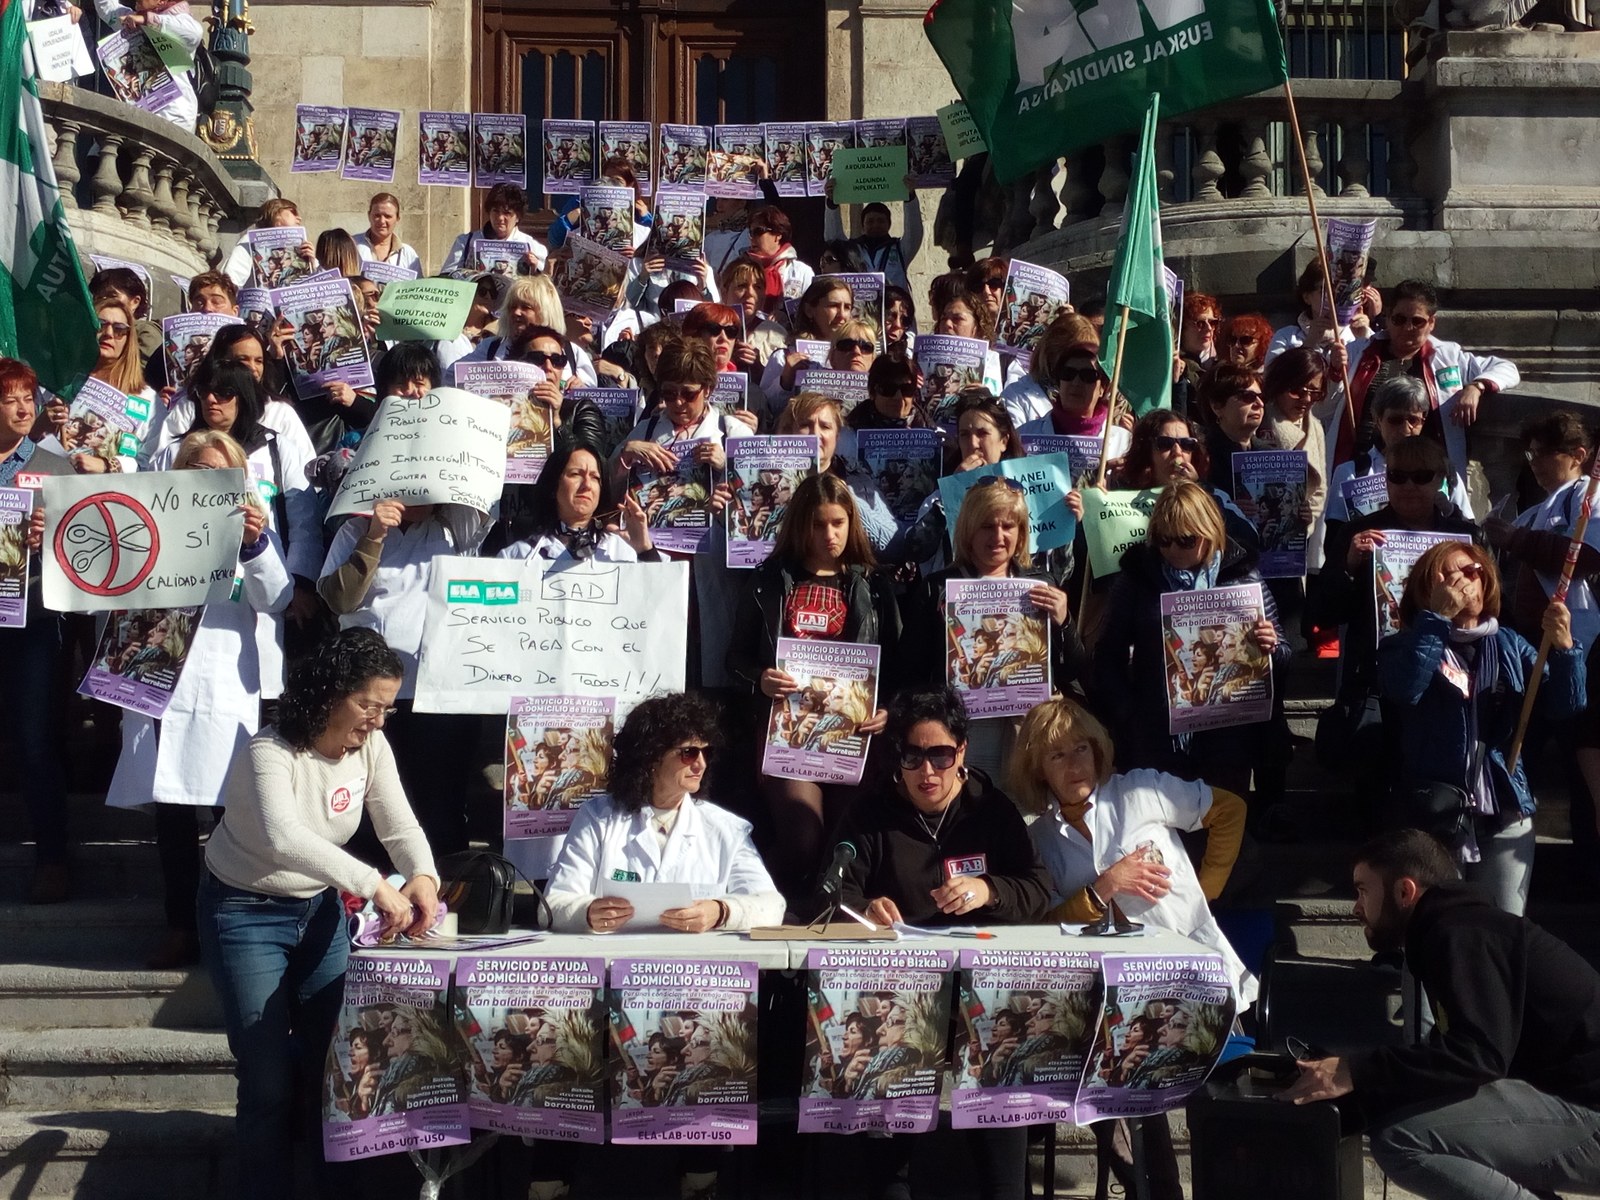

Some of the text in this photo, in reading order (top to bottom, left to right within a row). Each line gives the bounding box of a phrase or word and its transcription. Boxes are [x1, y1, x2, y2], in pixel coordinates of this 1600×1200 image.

[280, 288, 310, 297] SERVICIO
[396, 286, 460, 298] AYUNTAMIENTOS
[395, 295, 455, 305] RESPONSABLES
[395, 308, 448, 319] DIPUTACIÓN
[393, 318, 446, 328] IMPLICACIÓN
[806, 371, 835, 379] SERVICIO
[847, 373, 869, 381] AYUDA
[390, 470, 427, 481] CONTRA
[439, 470, 468, 482] ESTA
[151, 486, 180, 513] NO
[1100, 509, 1139, 520] BALIOA
[146, 573, 197, 590] CALIDAD
[960, 583, 996, 592] SERVICIO
[549, 579, 605, 600] SAD
[962, 591, 1002, 600] DOMICILIO
[1175, 595, 1213, 604] SERVICIO
[1226, 590, 1252, 599] AYUDA
[1177, 602, 1220, 612] DOMICILIO
[448, 607, 648, 630] SERVICIO PUBLICO QUE
[798, 614, 826, 626] LAB
[461, 632, 642, 655] SE PAGA CON EL
[791, 643, 867, 657] SERVICIO DE AYUDA
[792, 652, 833, 662] DOMICILIO
[845, 656, 873, 665] Bizkaia
[463, 664, 523, 686] DINERO
[525, 705, 568, 713] DOMICILIO
[949, 860, 986, 876] LAB
[376, 961, 392, 973] DE
[393, 961, 433, 974] AYUDA
[476, 960, 589, 973] SERVICIO DE AYUDA
[820, 956, 947, 968] A DOMICILIO de Bizkaia
[972, 956, 1100, 969] A DOMICILIO de Bizkaia
[1123, 960, 1190, 972] SERVICIO DE
[630, 963, 742, 977] SERVICIO DE AYUDA
[384, 974, 399, 985] de
[400, 974, 442, 986] Bizkaia
[467, 973, 599, 985] A DOMICILIO de Bizkaia
[622, 975, 751, 988] A DOMICILIO de Bizkaia
[1117, 972, 1196, 983] A DOMICILIO de
[822, 980, 941, 991] Lan baldintza duinak!
[974, 980, 994, 989] Lan
[996, 980, 1048, 990] baldintza
[345, 994, 394, 1006] baldintza
[468, 997, 591, 1009] Lan baldintza duinak!
[1118, 994, 1137, 1004] Lan
[1139, 989, 1184, 1001] baldintza
[1185, 990, 1227, 1005] duinak!
[623, 999, 745, 1011] Lan baldintza duinak!
[885, 1086, 936, 1098] borrokan!!
[406, 1094, 459, 1109] borrokan!!
[697, 1094, 750, 1105] borrokan!!
[543, 1100, 596, 1112] borrokan!!
[977, 1109, 1068, 1125] ELA-LAB-UGT-USO
[488, 1119, 580, 1140] ELA-LAB-UGT-USO
[638, 1131, 732, 1142] ELA-LAB-UGT-USO
[350, 1132, 446, 1157] ELA-LAB-UGT-USO
